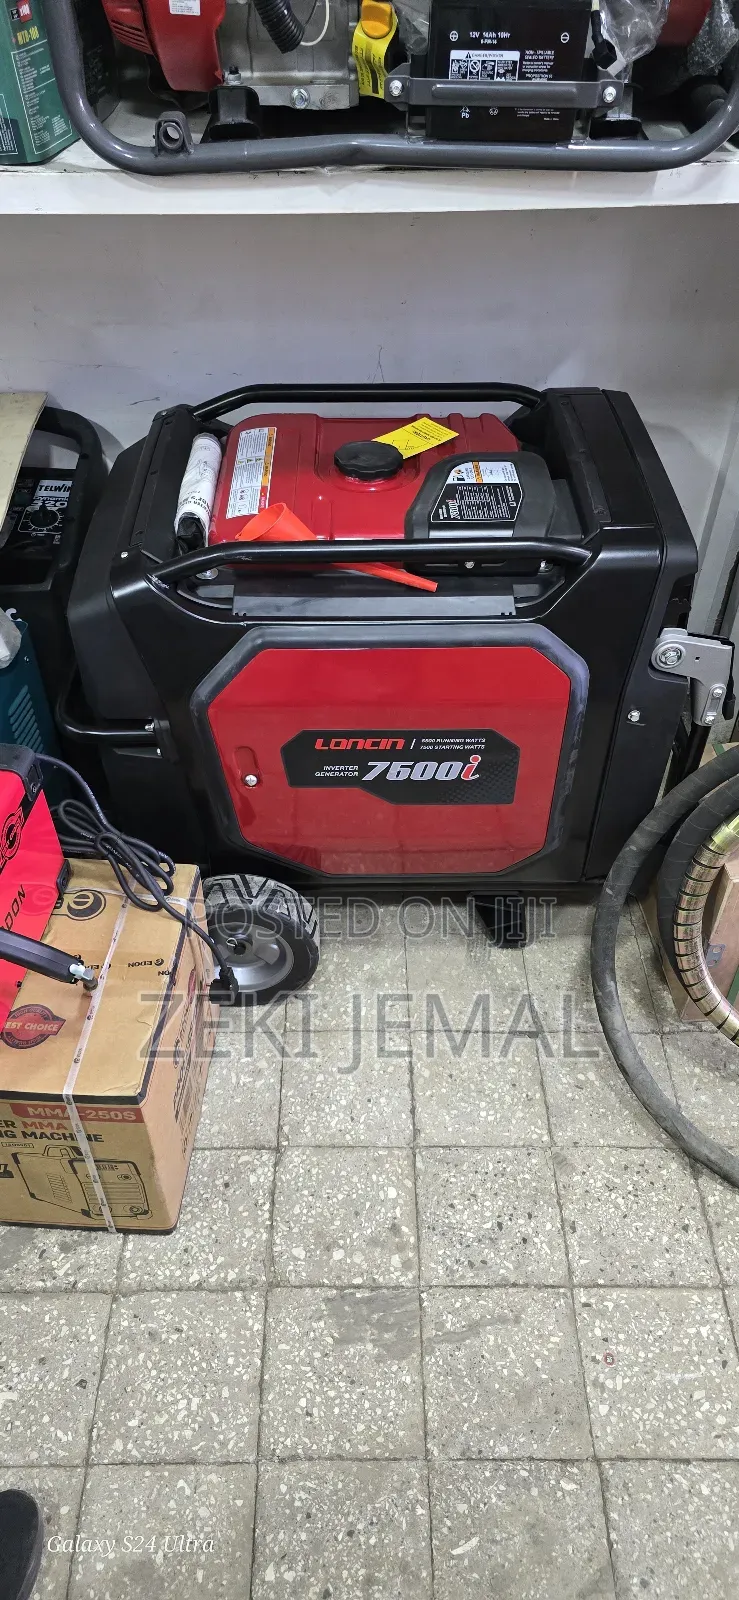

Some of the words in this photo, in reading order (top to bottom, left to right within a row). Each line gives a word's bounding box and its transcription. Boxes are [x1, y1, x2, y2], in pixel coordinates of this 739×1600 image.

[315, 738, 406, 750] LONCIN
[127, 960, 153, 968] EDON
[4, 1021, 22, 1029] EST
[24, 1022, 59, 1031] CHOICE
[21, 1121, 69, 1130] MMA
